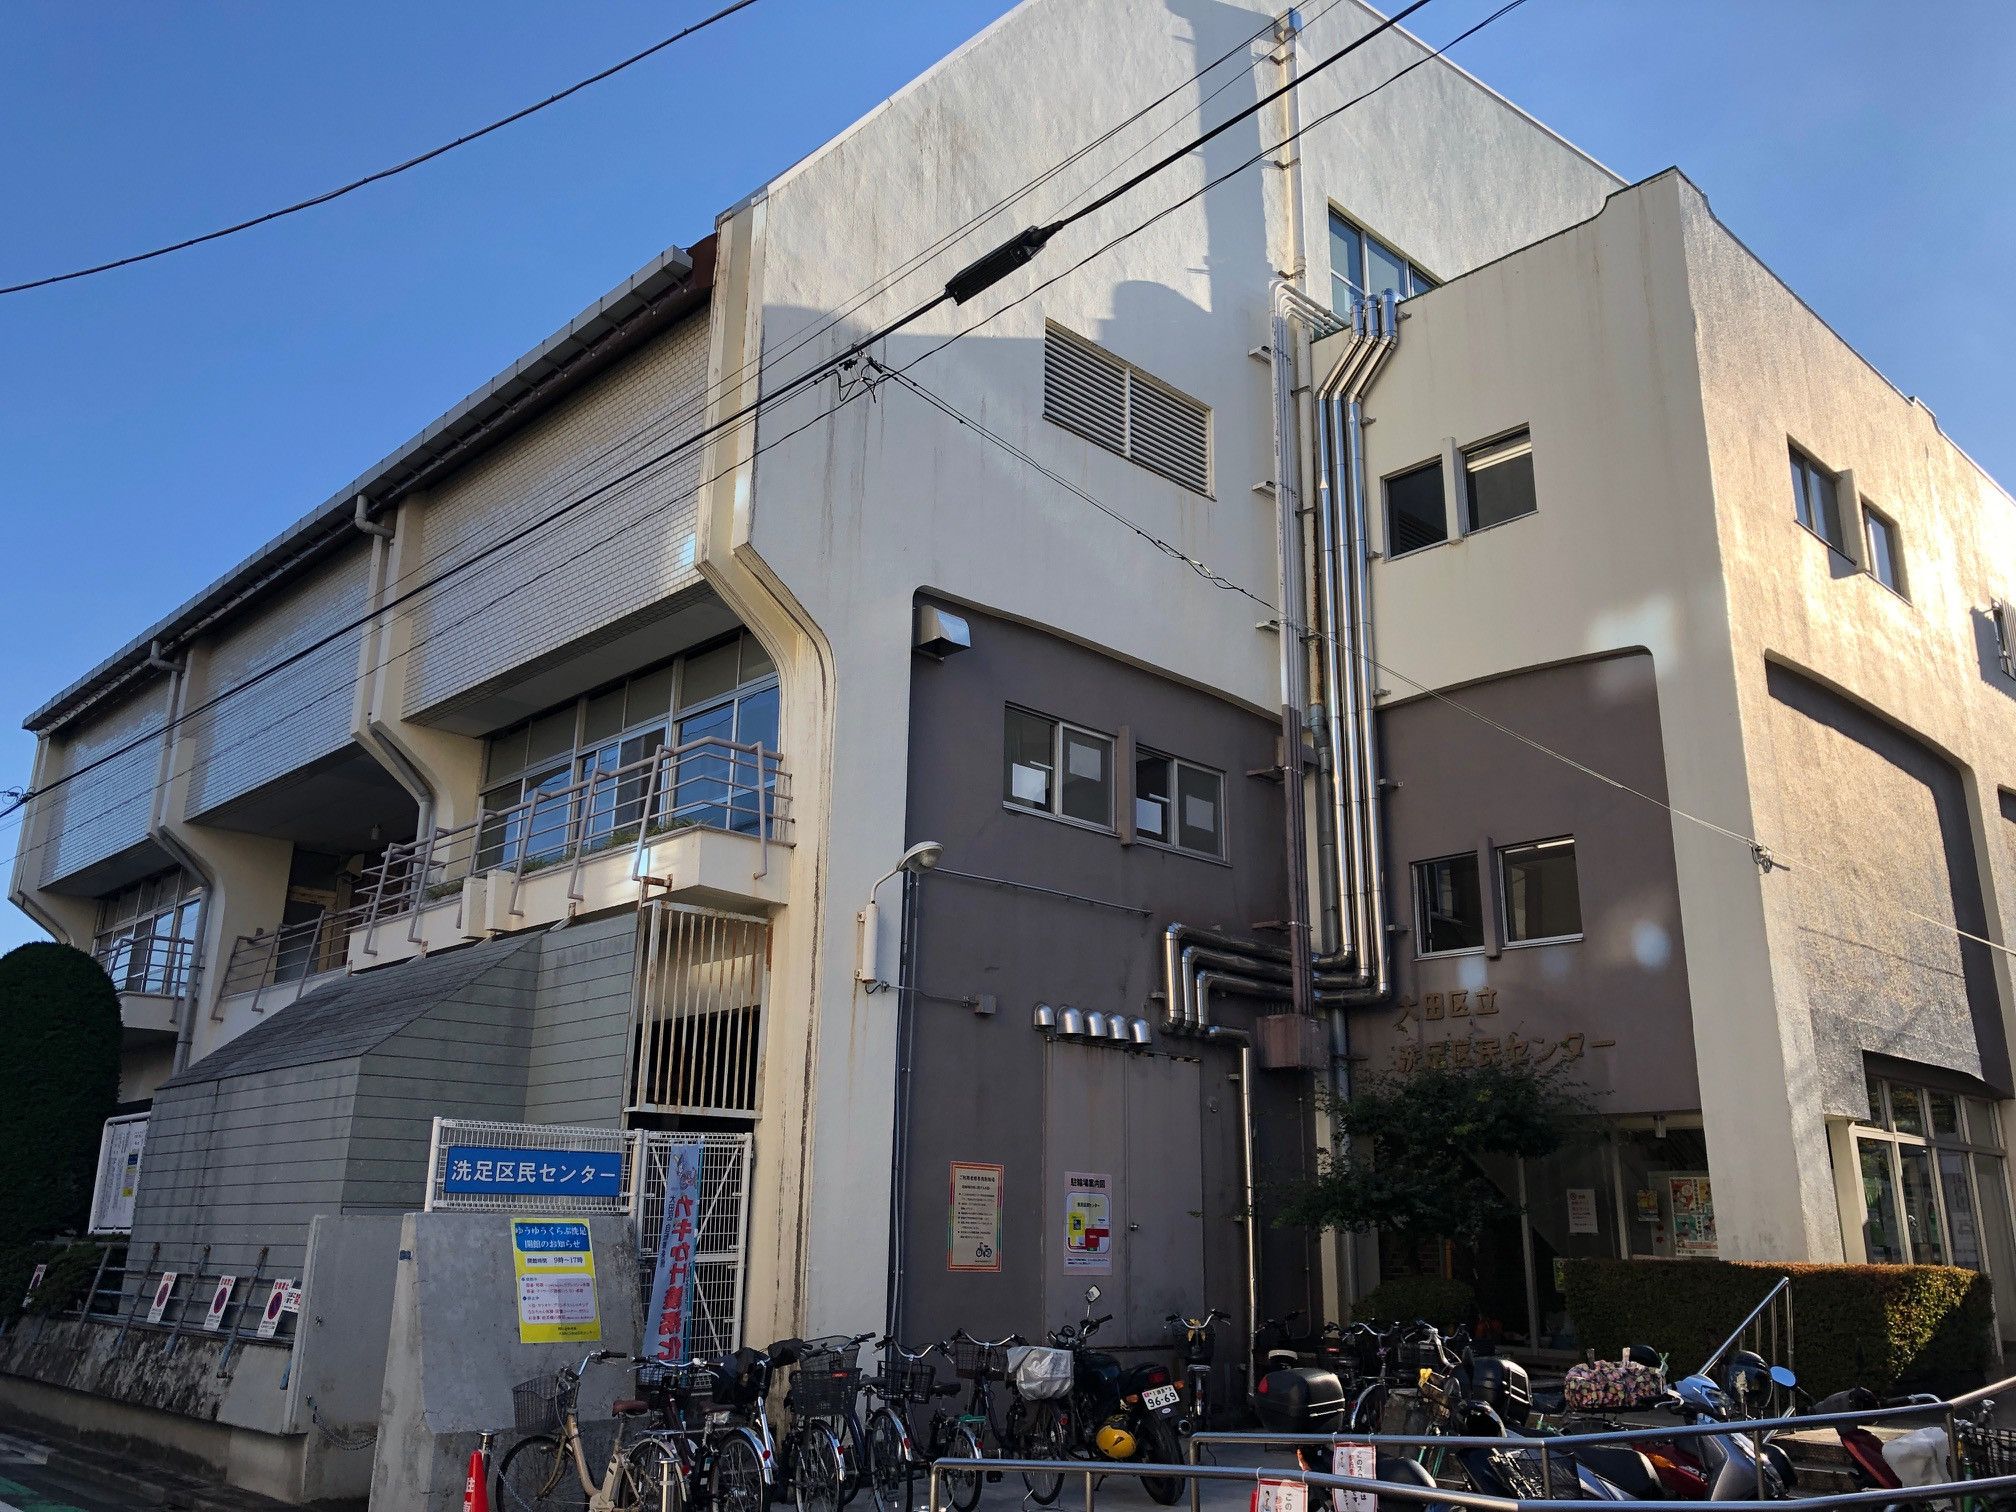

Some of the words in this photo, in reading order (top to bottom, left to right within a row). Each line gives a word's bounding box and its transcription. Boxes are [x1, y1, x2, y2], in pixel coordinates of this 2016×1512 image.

[1396, 986, 1500, 1023] 大田区立
[451, 1160, 616, 1185] 洗足区民センター
[515, 1227, 588, 1236] ゆうゆうくらぶ洗足
[524, 1239, 581, 1249] 開館のお知らせ
